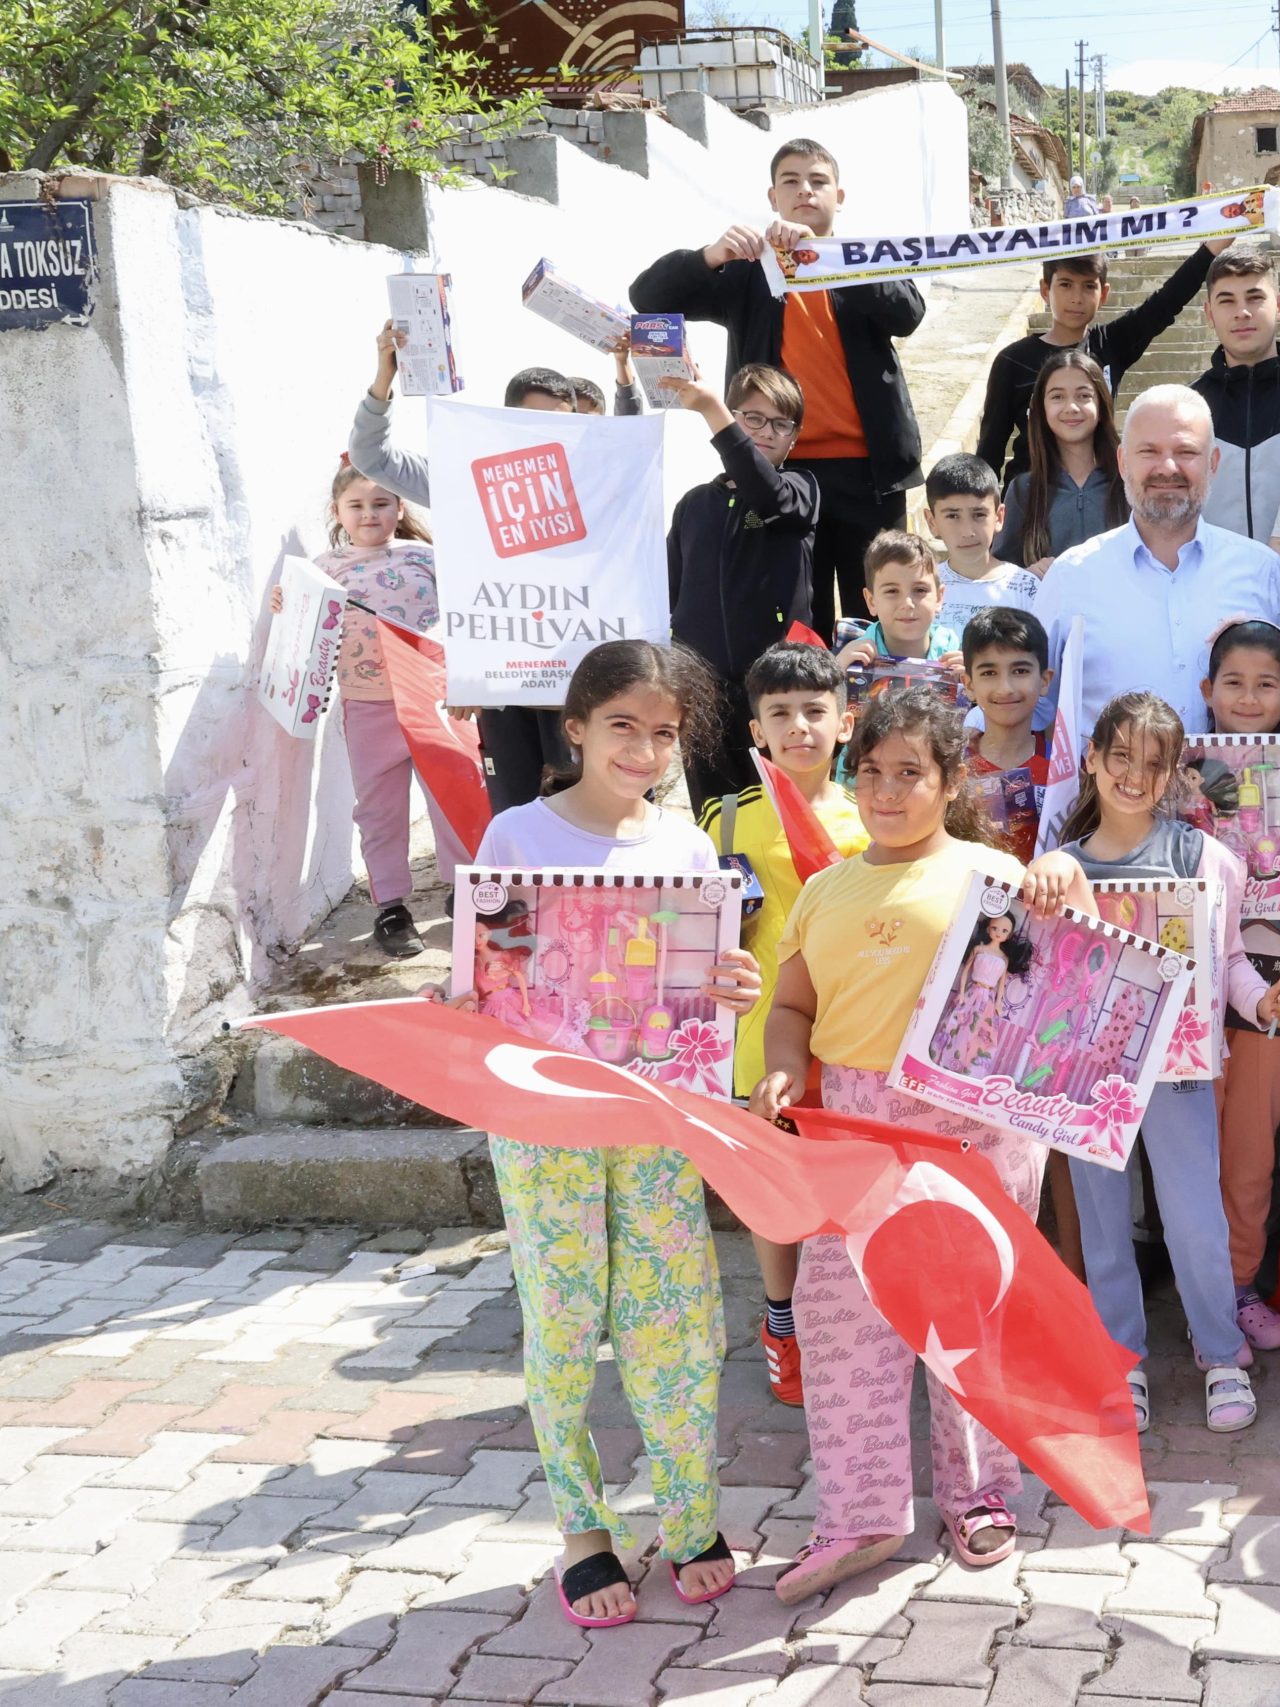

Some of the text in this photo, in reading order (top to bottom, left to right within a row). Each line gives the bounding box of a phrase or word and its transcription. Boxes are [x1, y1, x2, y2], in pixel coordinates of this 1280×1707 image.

[841, 207, 1198, 266] BAŞLAYALIM MI ?
[13, 240, 86, 278] TOKSUZ
[482, 453, 558, 485] MENEMEN
[488, 471, 568, 524] İÇİN
[499, 512, 575, 548] EN İYİSİ
[472, 581, 591, 610] AYDIN
[446, 611, 627, 649] PEHLİVAN
[310, 636, 336, 687] Beauty
[505, 660, 567, 670] MENEMEN
[485, 669, 573, 681] BELEDİYE BAŞK
[520, 680, 557, 689] ADAYI
[986, 893, 1003, 904] BEST
[1255, 902, 1277, 913] Girl
[900, 1074, 926, 1094] EFE
[959, 1087, 979, 1099] Girl
[888, 1100, 936, 1122] Barbie
[982, 1076, 1076, 1126] Beauty
[1008, 1114, 1079, 1145] Candy Girl
[803, 1308, 861, 1330] Barbie
[806, 1346, 853, 1368] Barbie
[810, 1393, 850, 1413] Barbie
[846, 1412, 898, 1434] Barbie
[863, 1433, 910, 1453] Barbie
[844, 1455, 891, 1476] Barbie
[856, 1473, 906, 1493] Barbie
[847, 1513, 898, 1533] Barbie
